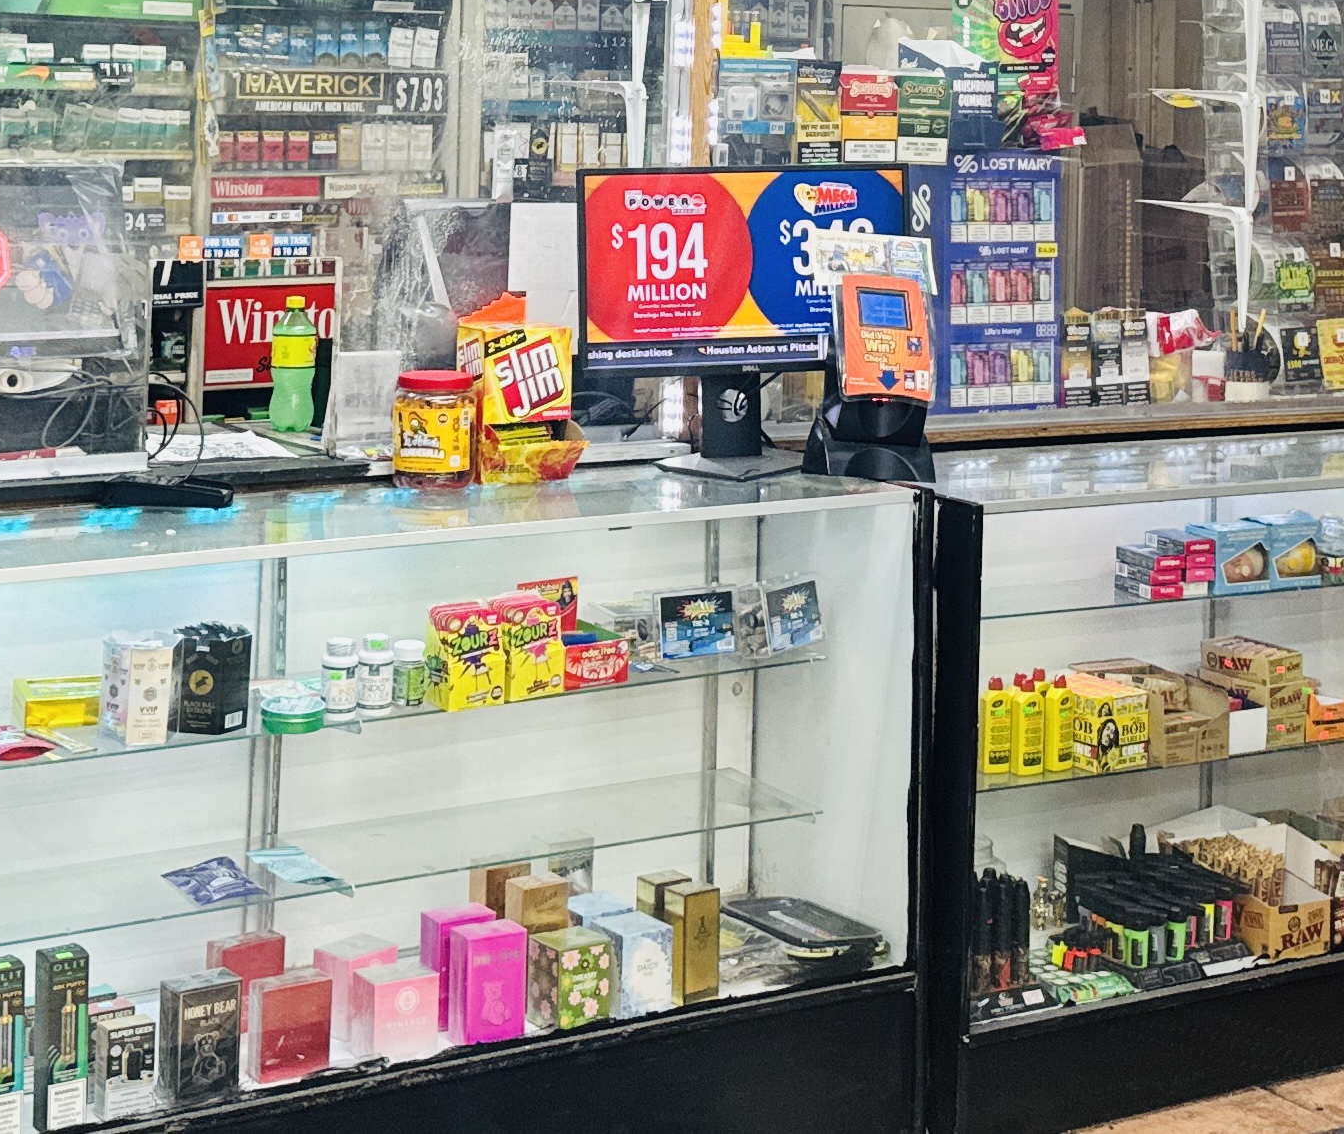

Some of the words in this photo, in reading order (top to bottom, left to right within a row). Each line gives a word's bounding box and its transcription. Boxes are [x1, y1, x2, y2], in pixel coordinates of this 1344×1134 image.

[245, 73, 374, 95] MAVERICK
[981, 157, 1014, 171] LOST
[1018, 156, 1052, 170] MARY
[215, 181, 263, 196] Winston
[612, 222, 708, 280] $194
[628, 283, 707, 301] MILLION
[865, 340, 896, 354] Win?
[495, 343, 559, 388] slim
[513, 366, 564, 416] jim
[1277, 693, 1301, 708] RAW
[1122, 720, 1146, 736] BOB
[1281, 924, 1324, 950] RAW
[53, 959, 86, 972] OLIT
[184, 1004, 212, 1020] HONEY
[214, 999, 237, 1013] BEAR
